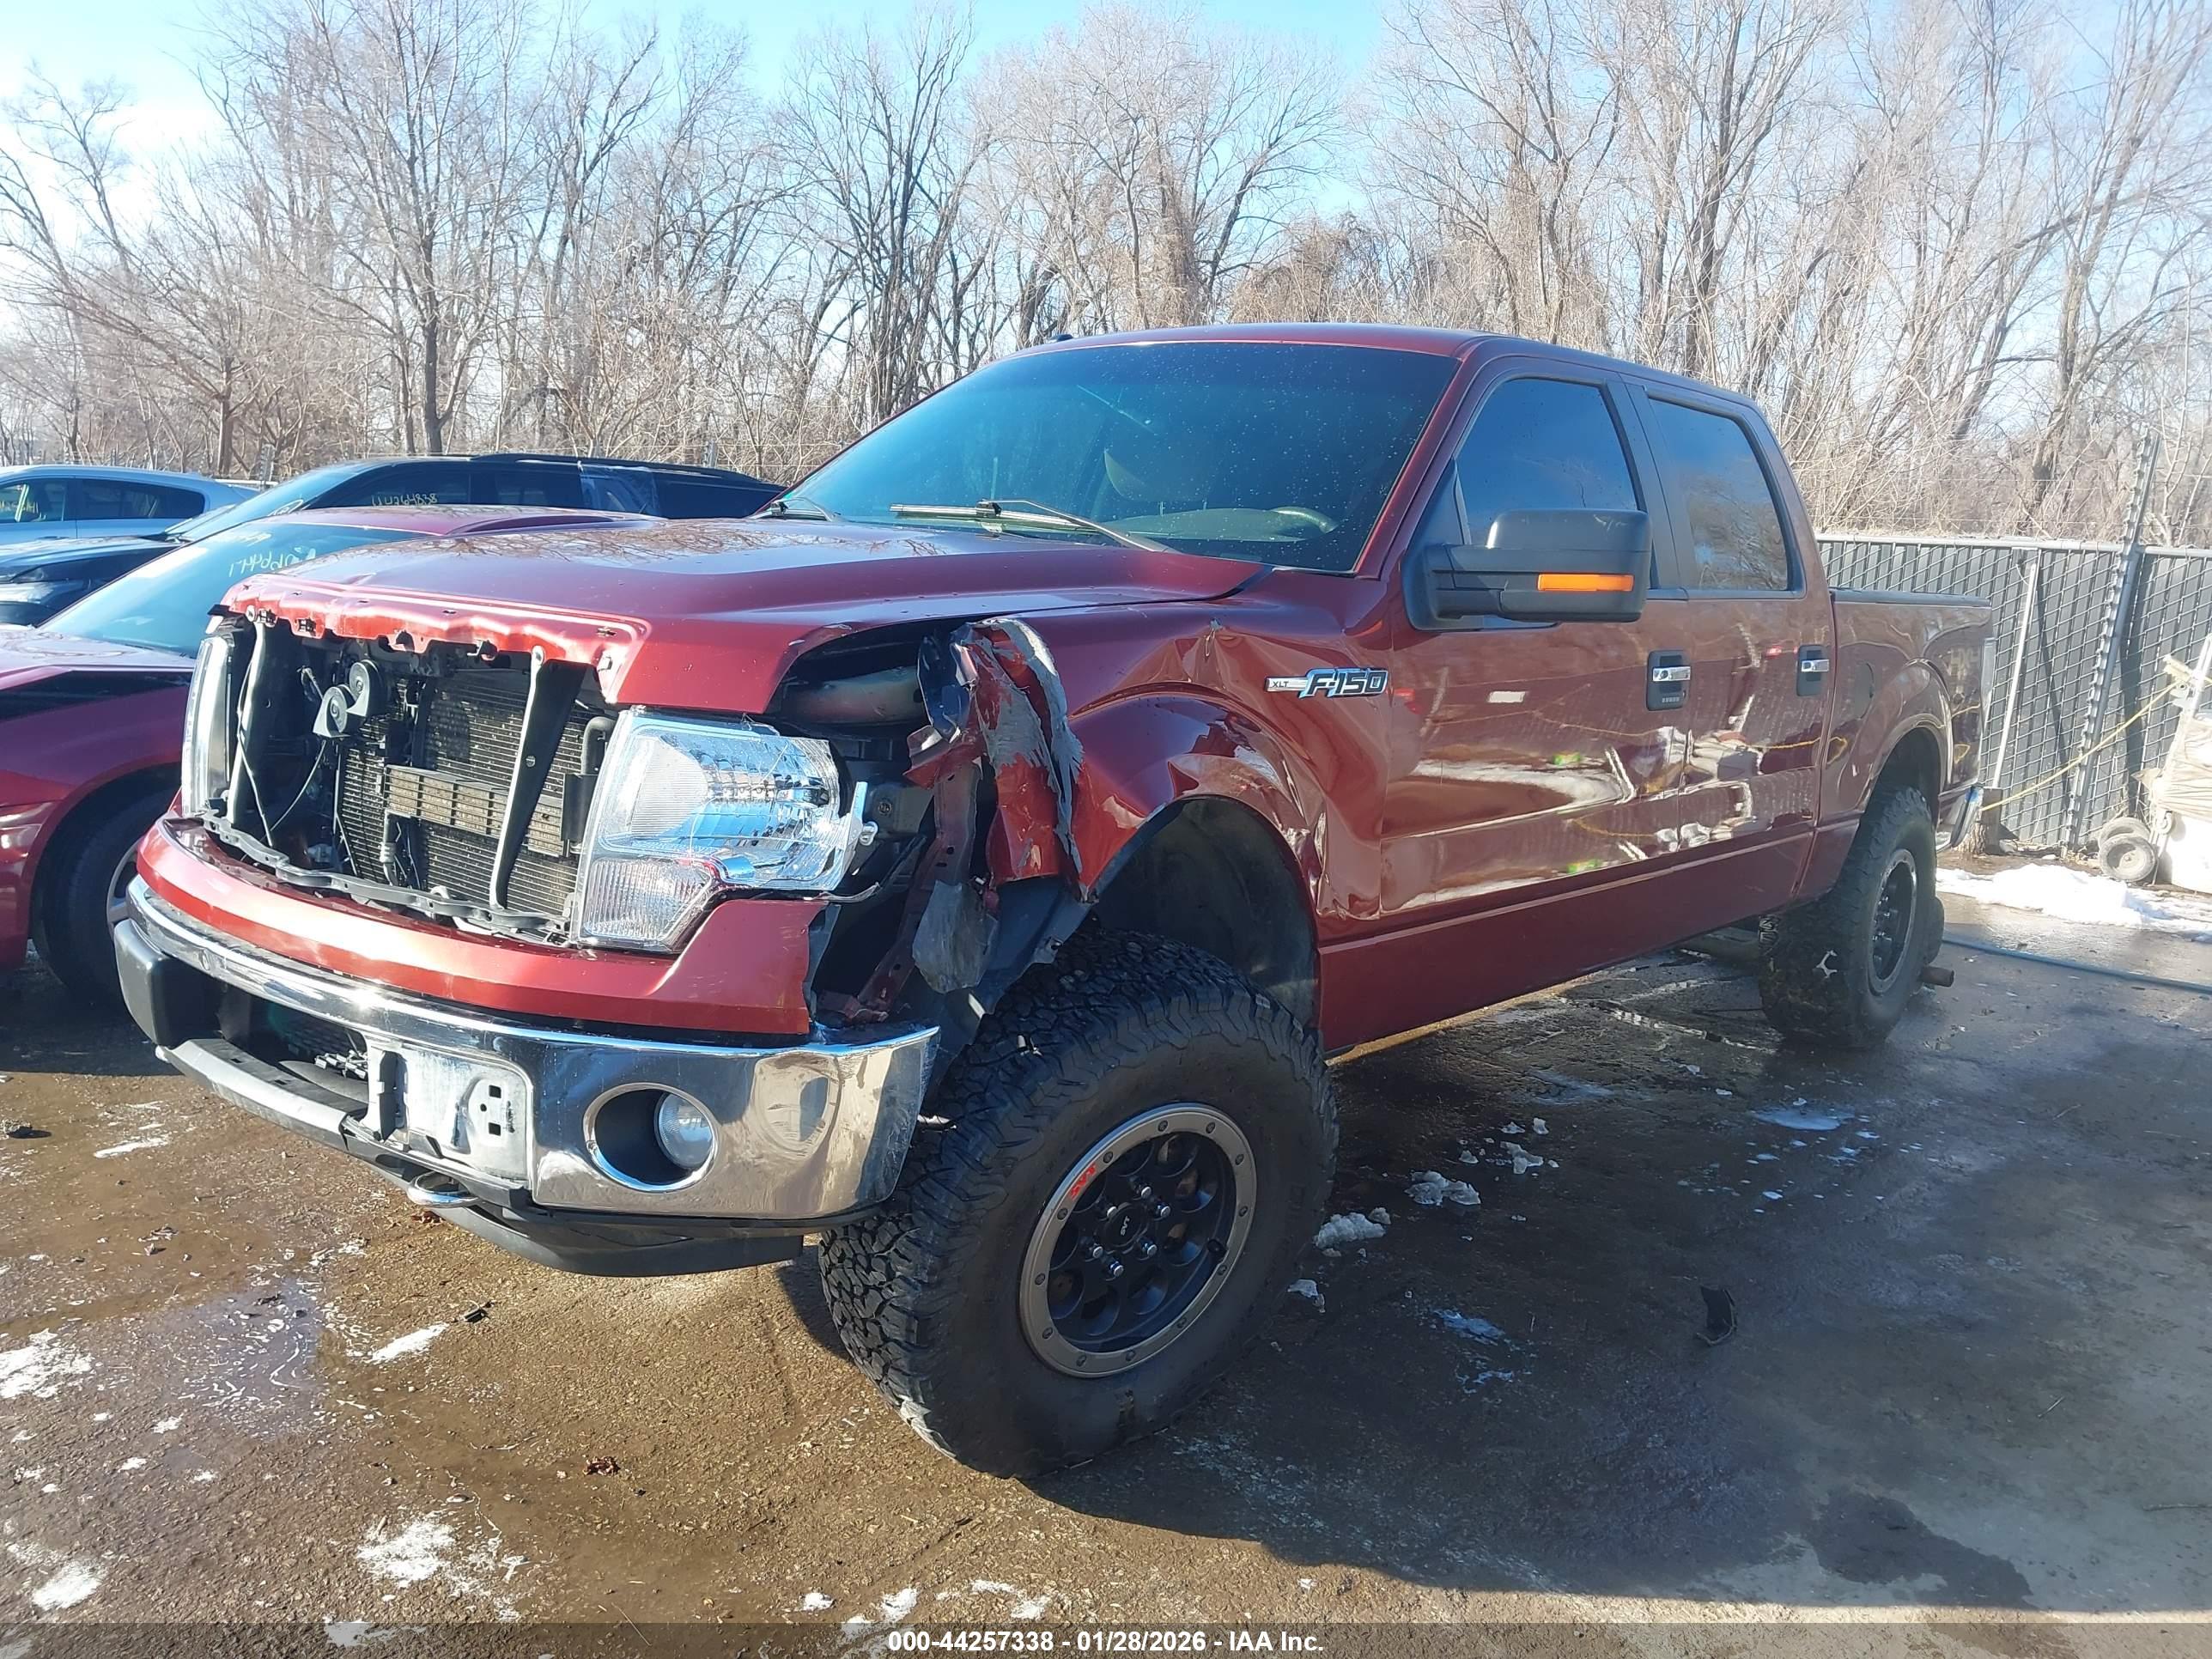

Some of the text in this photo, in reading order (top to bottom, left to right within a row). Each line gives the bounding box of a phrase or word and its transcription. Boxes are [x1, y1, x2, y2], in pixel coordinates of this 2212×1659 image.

[1271, 669, 1388, 696] XLT F-150
[1071, 1162, 1097, 1199] SVT
[1120, 1215, 1131, 1237] SVT
